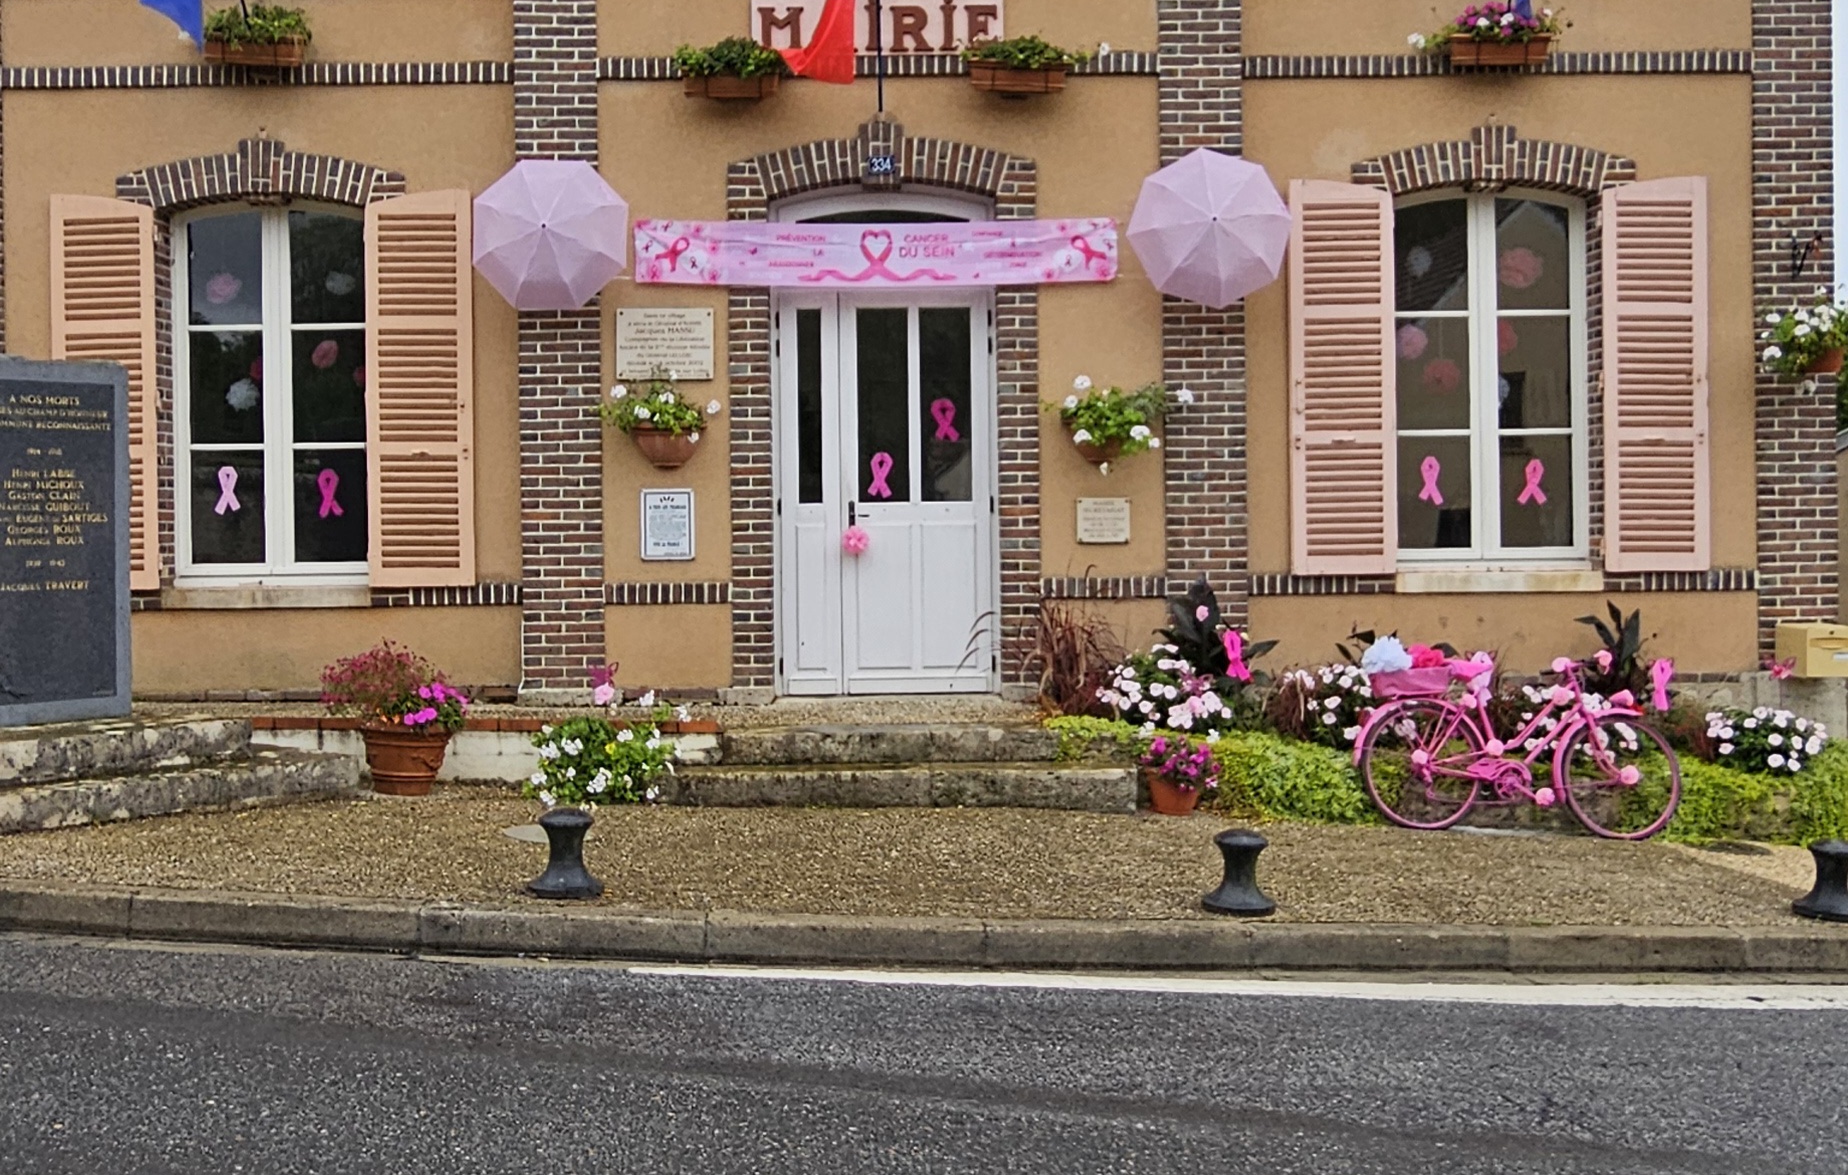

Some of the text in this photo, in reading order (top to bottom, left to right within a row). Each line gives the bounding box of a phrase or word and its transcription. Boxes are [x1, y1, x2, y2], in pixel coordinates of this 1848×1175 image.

[776, 233, 826, 242] PRÉVENTION
[903, 233, 949, 244] CANCER
[898, 244, 956, 258] DU SEIN
[9, 394, 80, 406] A NOS MORTS
